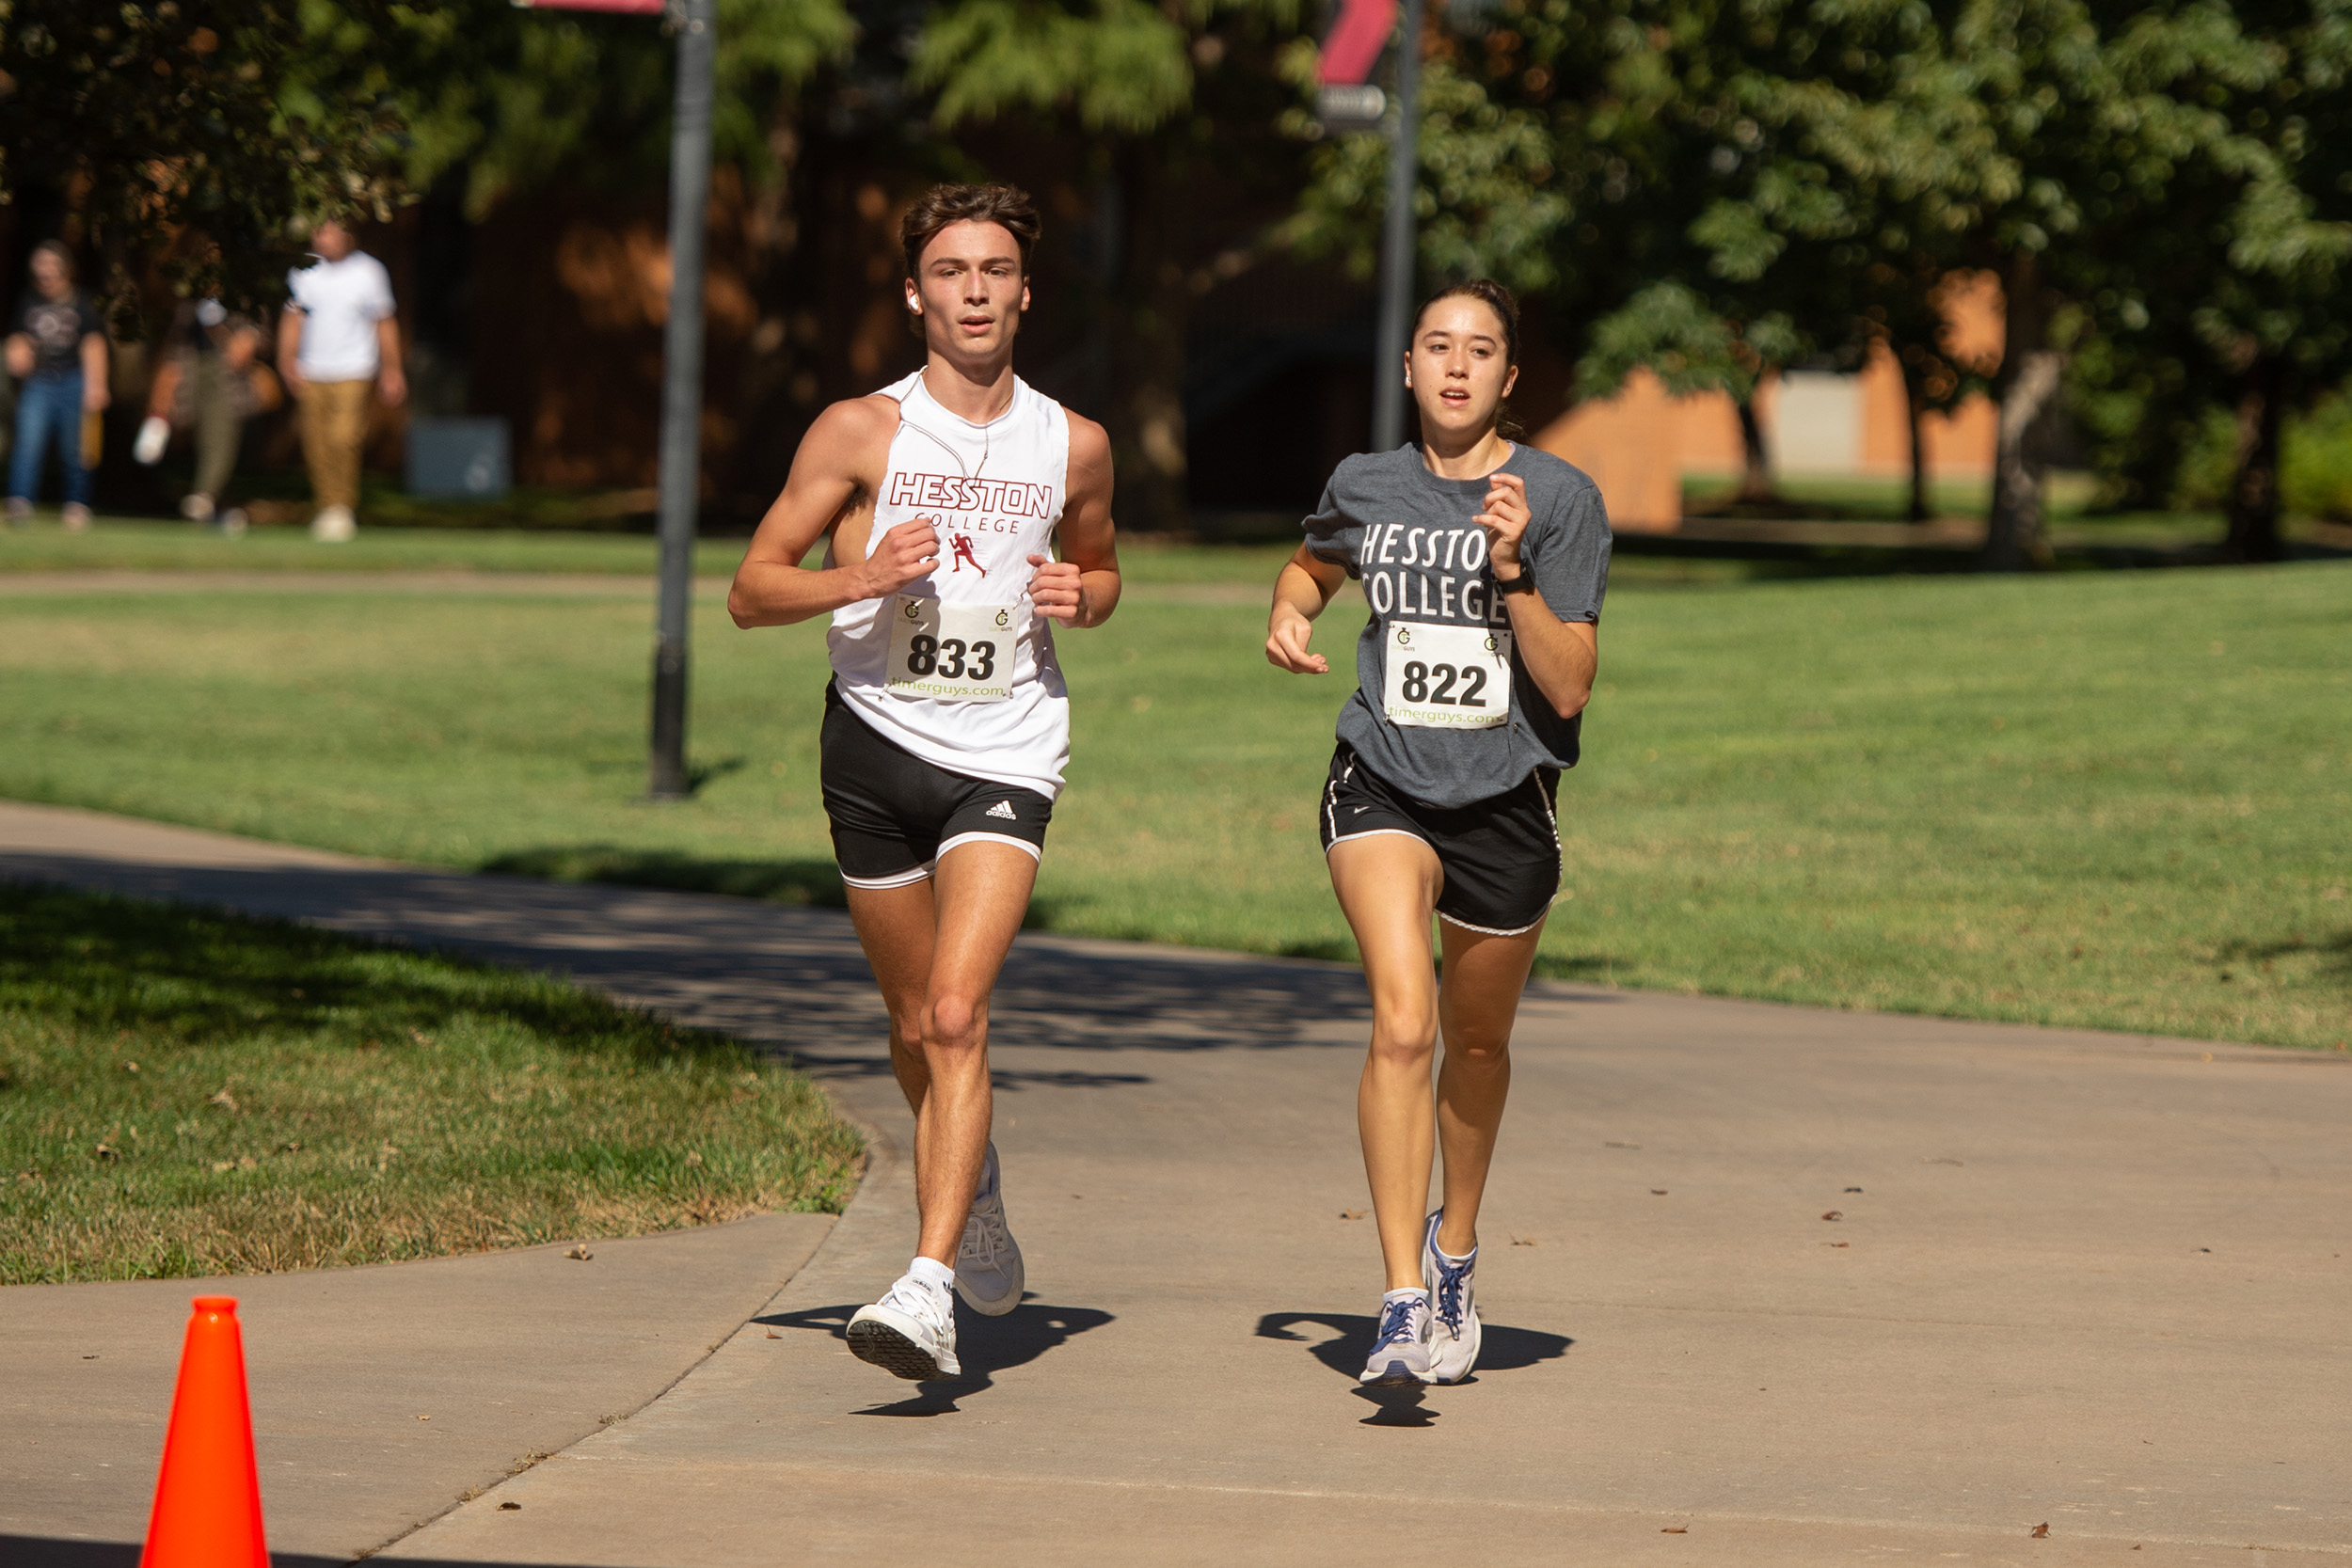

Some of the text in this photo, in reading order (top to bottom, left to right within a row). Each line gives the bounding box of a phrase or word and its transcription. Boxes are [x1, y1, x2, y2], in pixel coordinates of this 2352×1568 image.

[889, 472, 1052, 519] HESSTON
[1360, 523, 1486, 572] HESSTO
[907, 634, 996, 681] 833
[891, 676, 1004, 696] timerguys.com
[1402, 660, 1487, 707] 822
[1389, 706, 1500, 723] timerguys.com
[986, 810, 1017, 820] adidas
